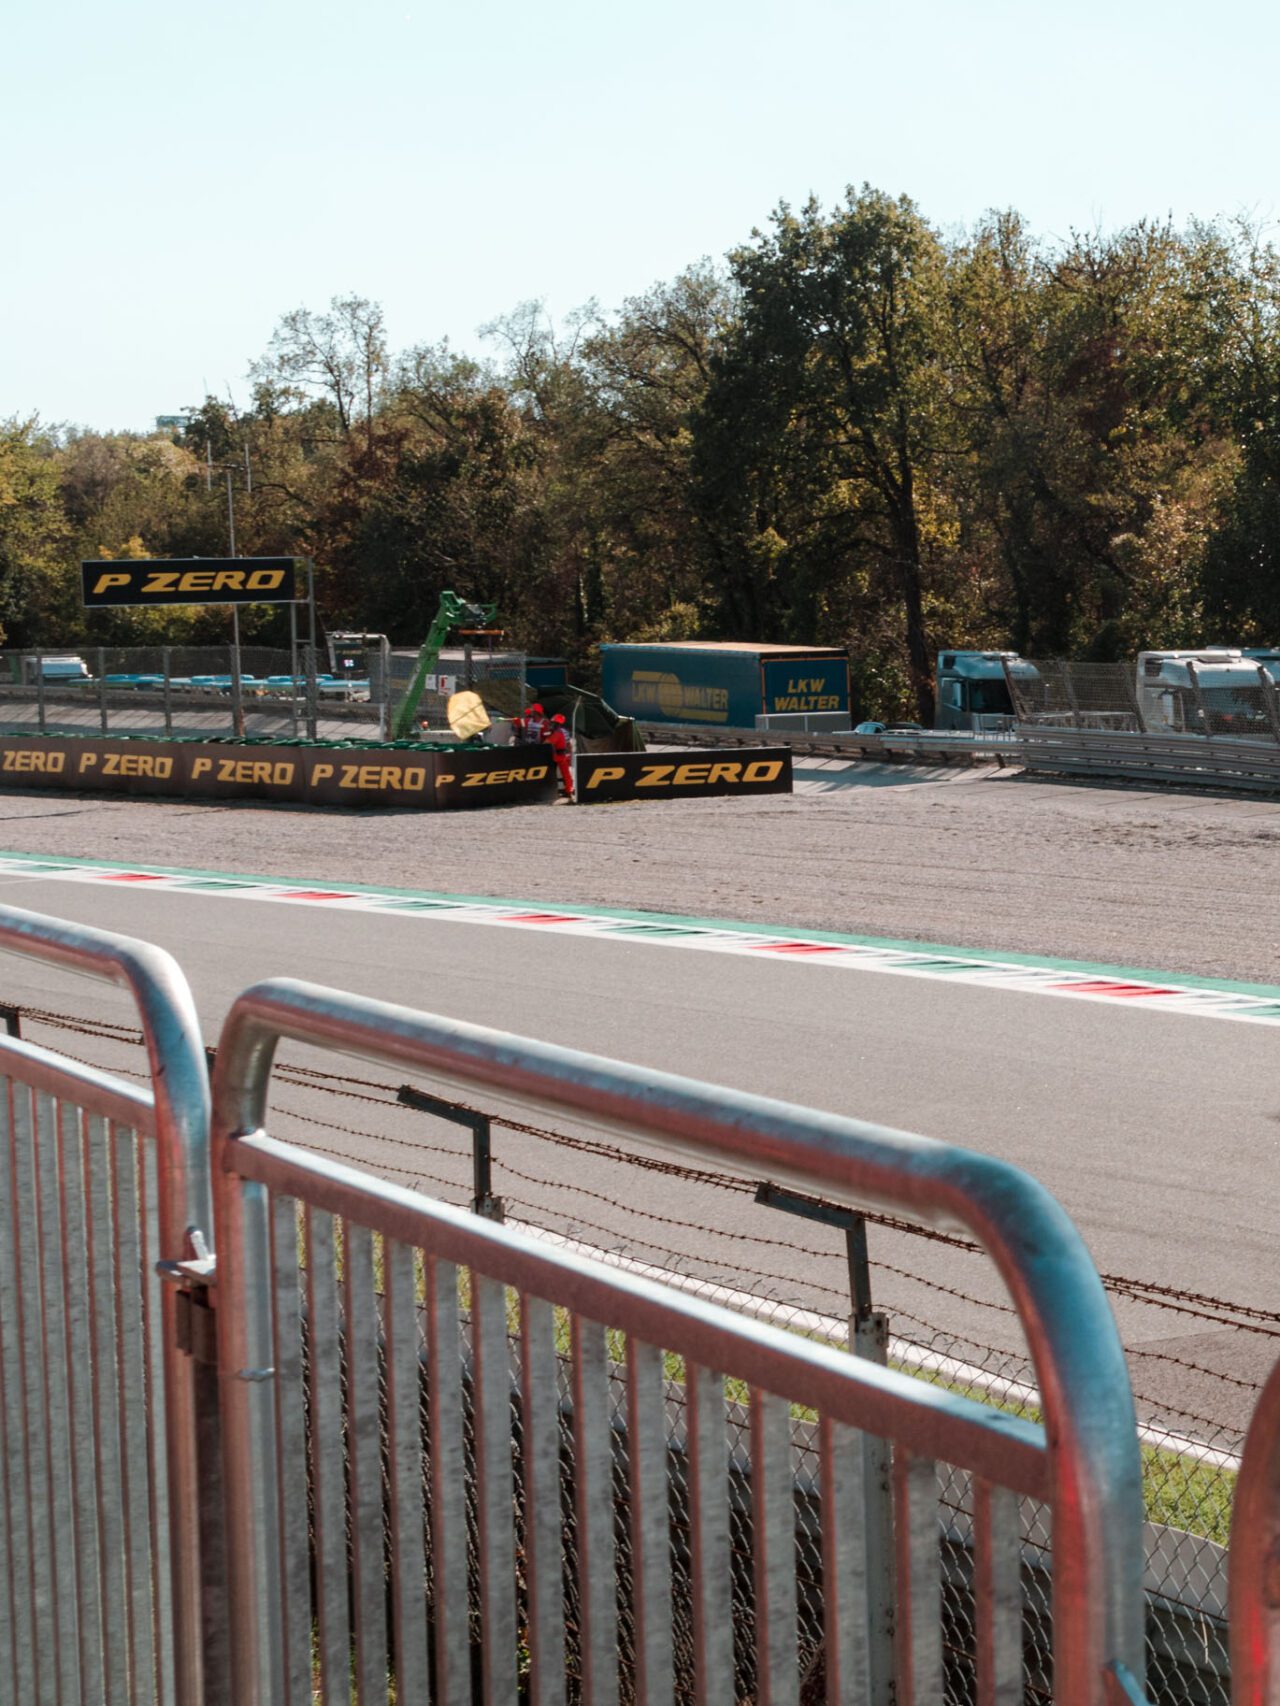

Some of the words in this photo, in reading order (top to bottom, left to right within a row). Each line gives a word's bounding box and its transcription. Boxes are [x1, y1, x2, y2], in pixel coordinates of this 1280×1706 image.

[92, 573, 132, 594] P
[141, 570, 286, 593] ZERO
[787, 679, 825, 694] LKW
[684, 687, 728, 710] WALTER
[774, 695, 839, 711] WALTER
[2, 751, 65, 773] ZERO
[79, 753, 97, 773] P
[102, 753, 173, 779] ZERO
[191, 758, 213, 779] P
[217, 759, 295, 785] ZERO
[310, 764, 333, 786] P
[339, 765, 426, 791] ZERO
[435, 774, 455, 788] P
[461, 765, 548, 787] ZERO
[585, 767, 626, 789] P
[634, 761, 783, 787] ZERO
